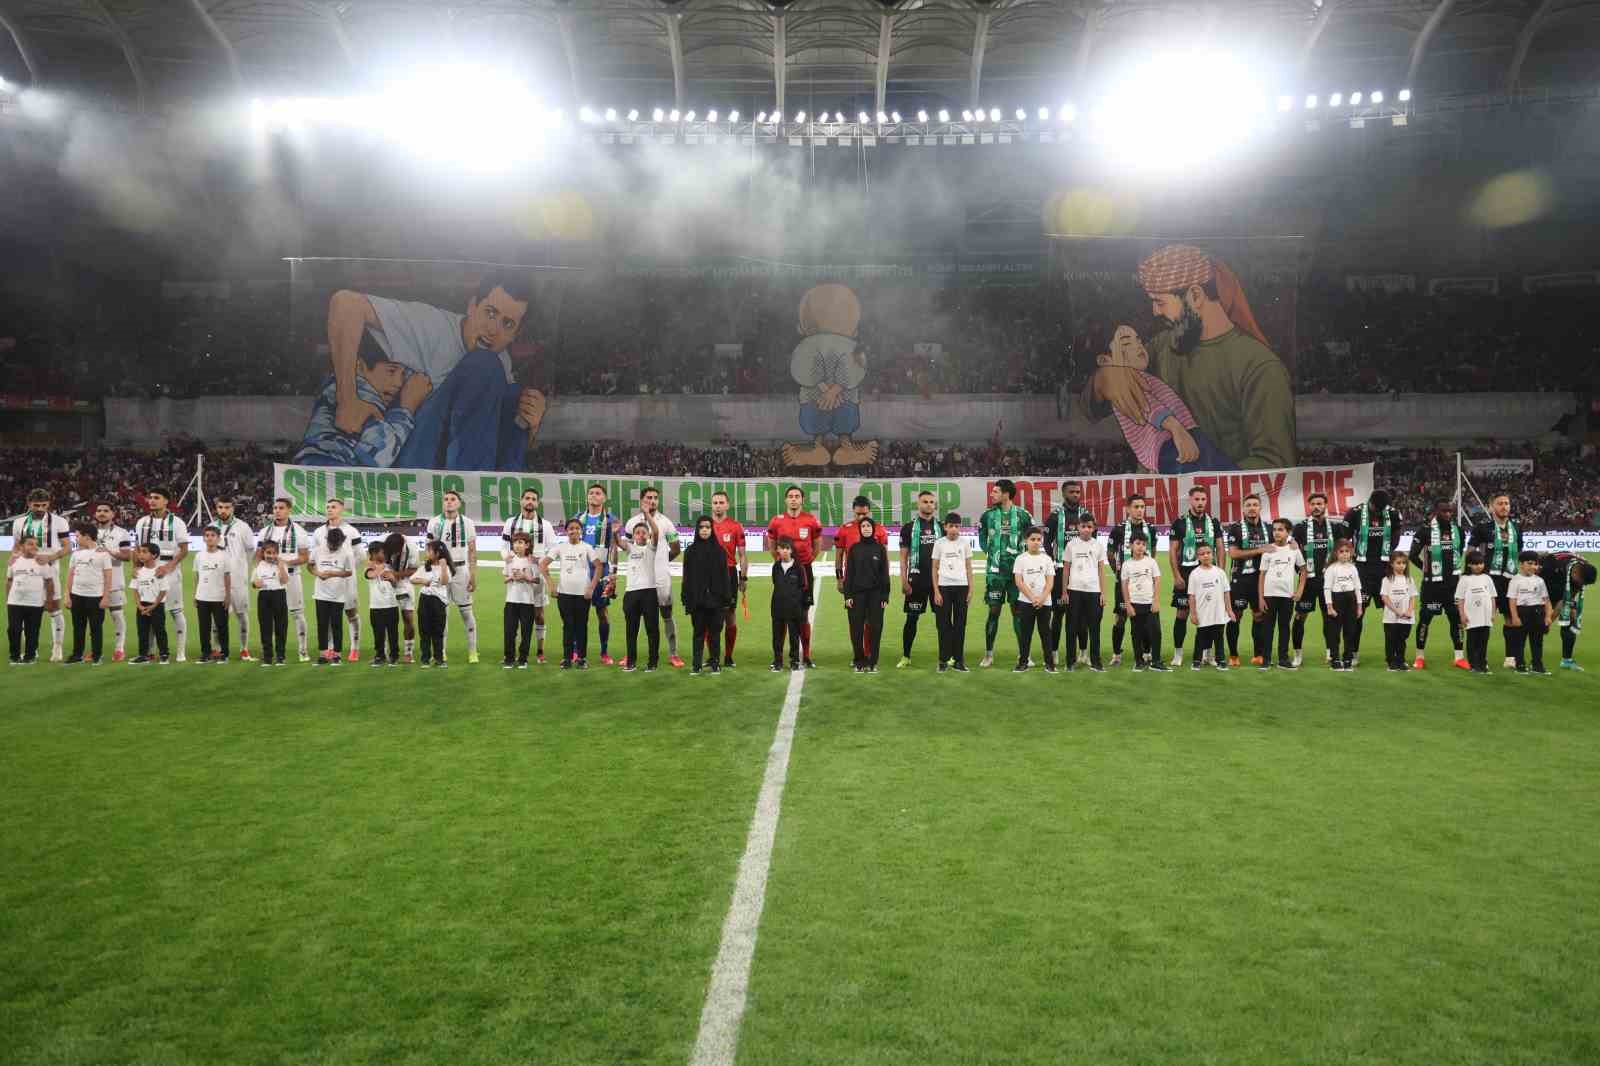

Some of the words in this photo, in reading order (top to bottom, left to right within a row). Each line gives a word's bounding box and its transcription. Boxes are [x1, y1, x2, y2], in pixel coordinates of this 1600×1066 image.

[283, 468, 417, 519] SILENCE
[432, 474, 465, 517] IS
[859, 481, 971, 527] SLEP.
[1303, 469, 1354, 516] DIE
